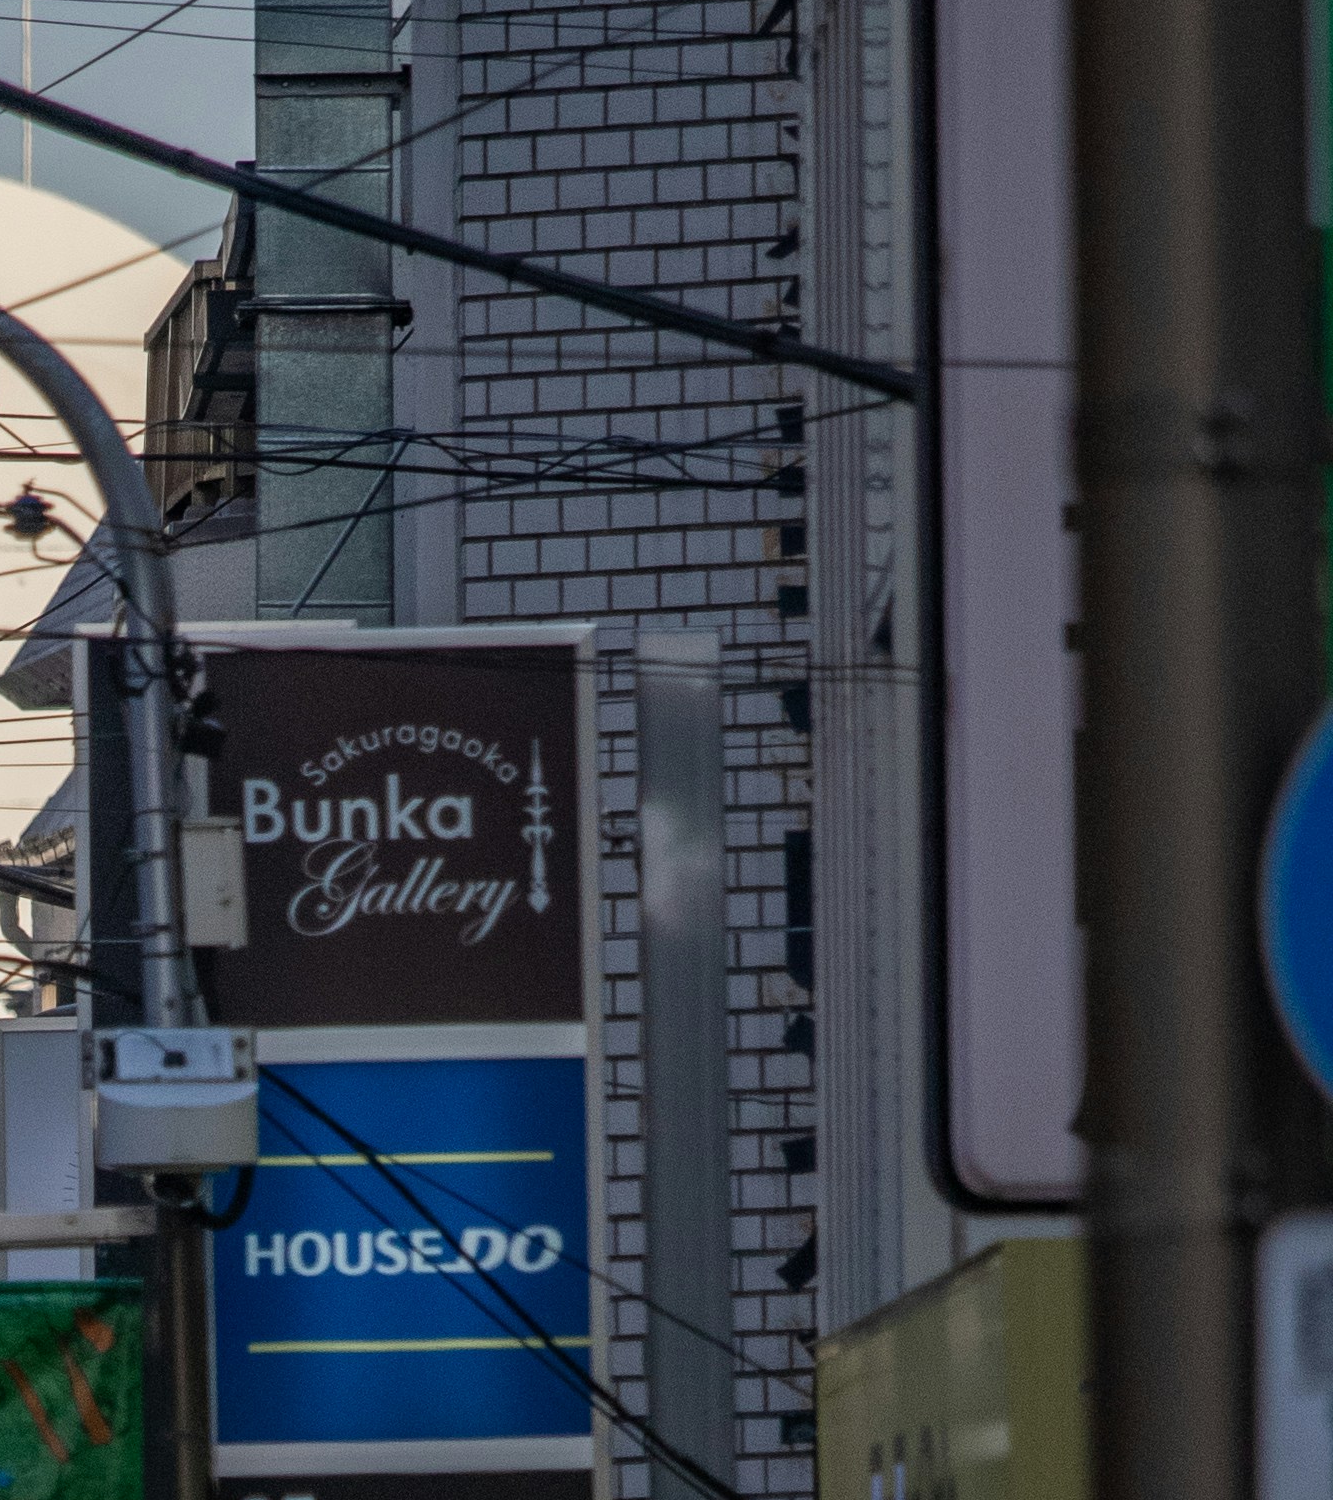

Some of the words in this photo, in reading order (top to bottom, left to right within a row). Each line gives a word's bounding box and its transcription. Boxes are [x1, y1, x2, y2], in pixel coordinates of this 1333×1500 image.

[299, 723, 520, 787] Sakuragaoka
[243, 772, 475, 844] Bunka
[286, 838, 517, 947] Gallery
